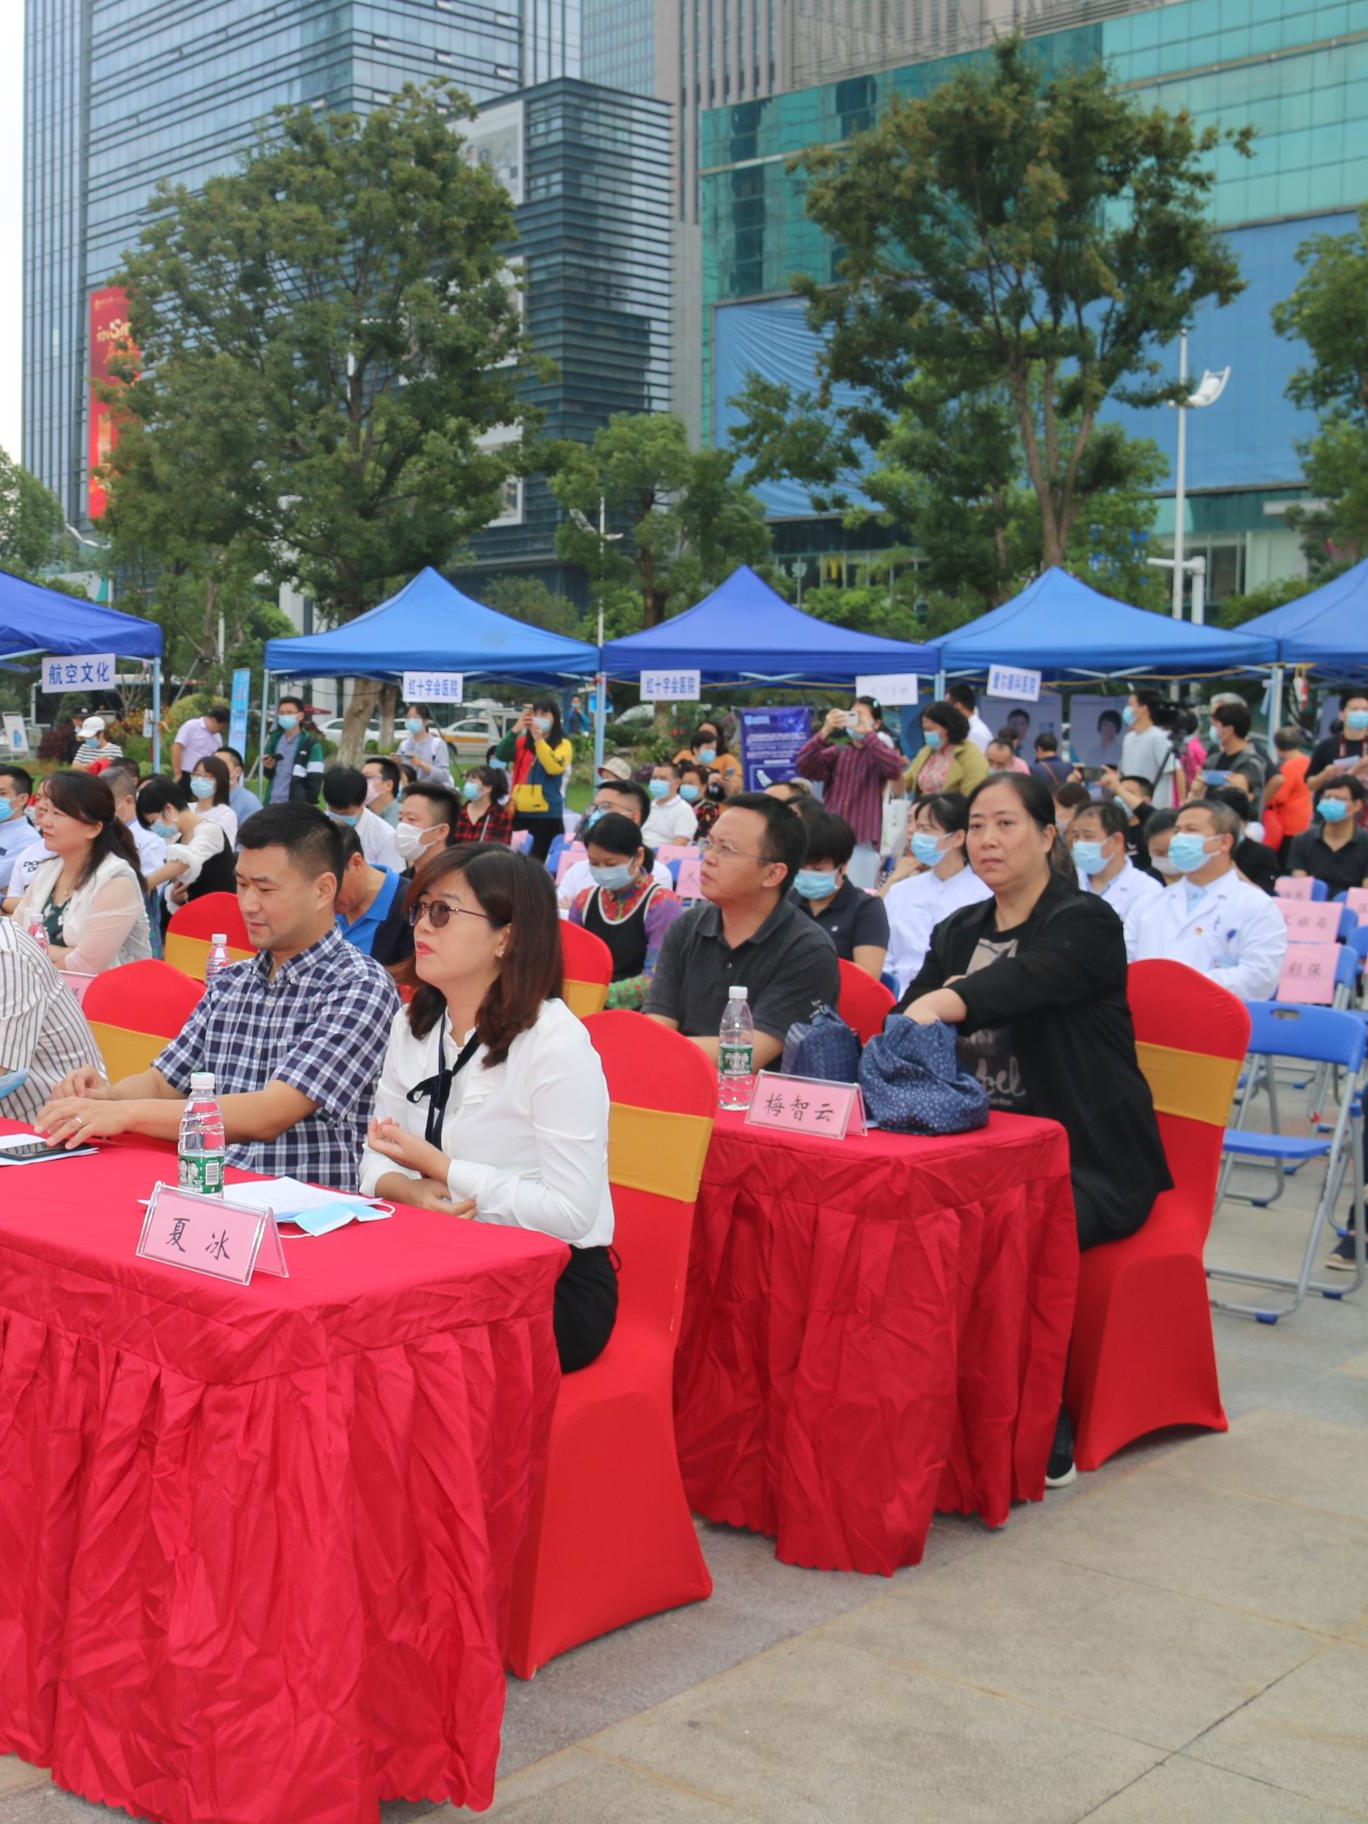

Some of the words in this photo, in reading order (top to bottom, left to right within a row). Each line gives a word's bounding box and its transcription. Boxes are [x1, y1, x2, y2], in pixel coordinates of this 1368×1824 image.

[48, 660, 110, 686] 航空文化
[645, 676, 696, 694] 红十字会医院
[407, 677, 459, 697] 红十字会医院
[763, 1092, 834, 1122] 梅智云
[165, 1217, 231, 1260] 夏冰
